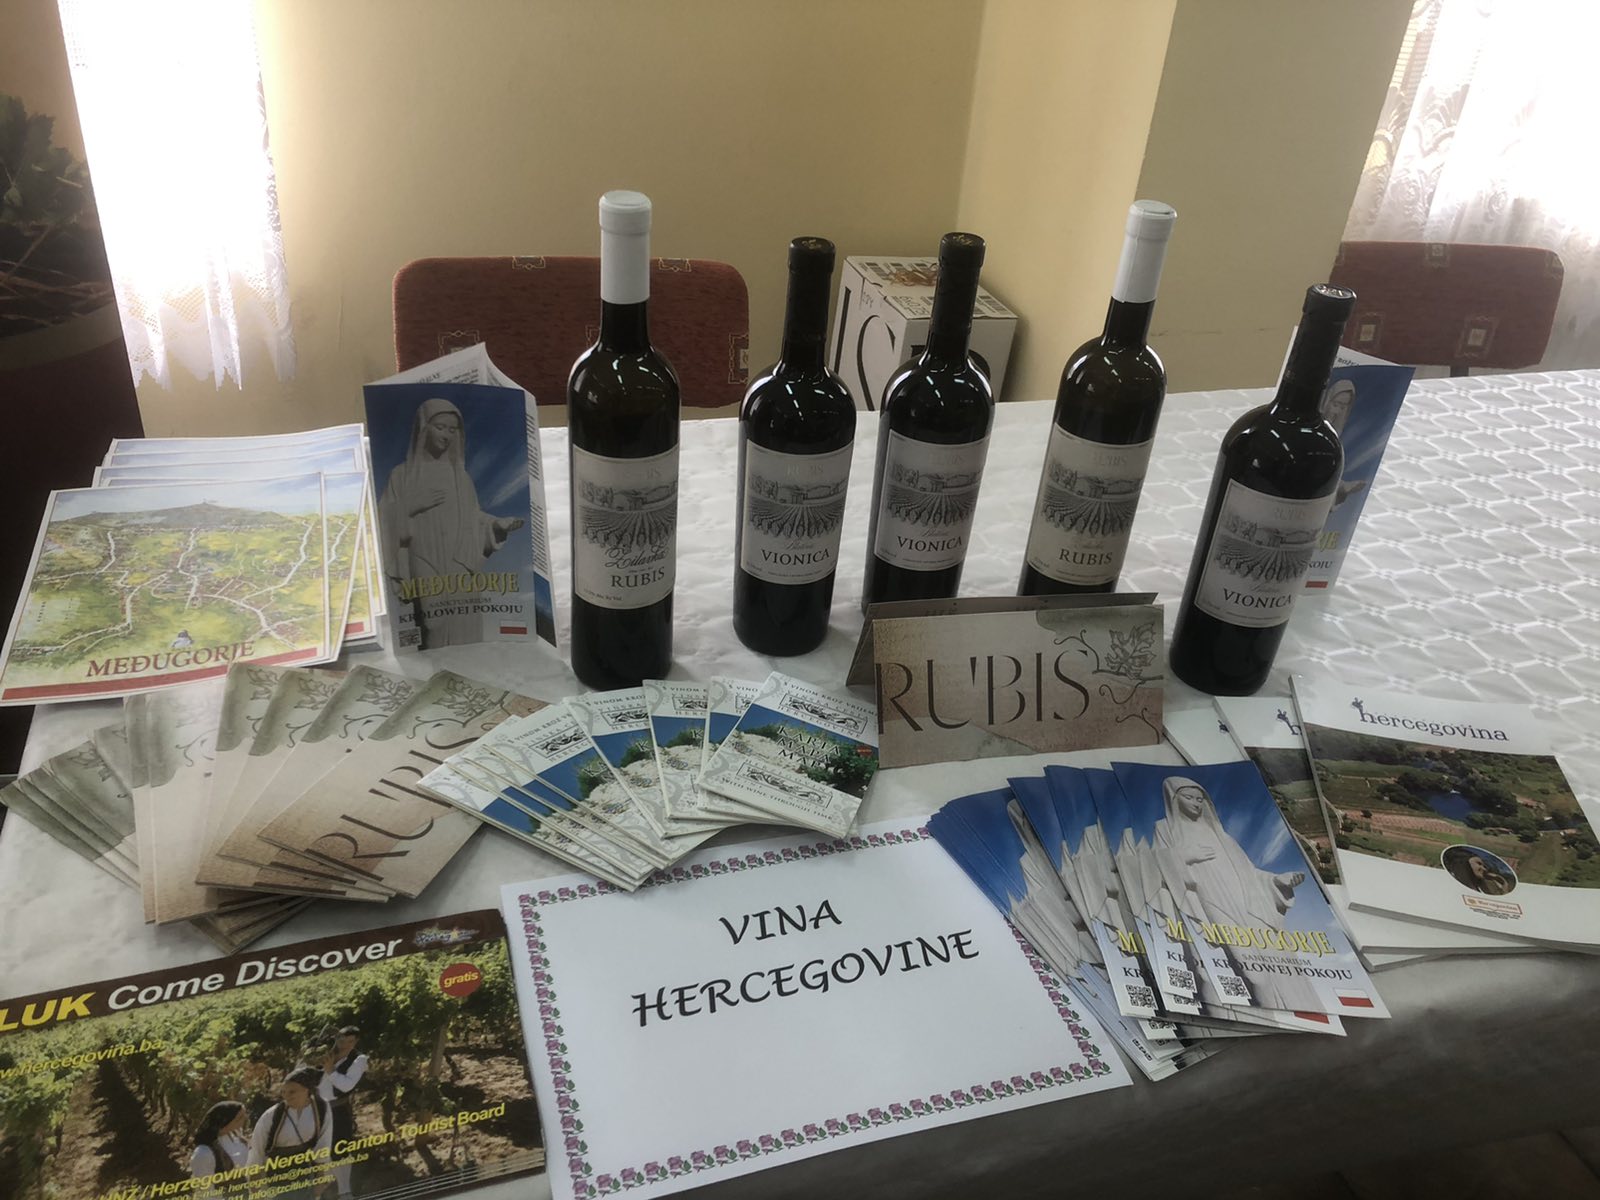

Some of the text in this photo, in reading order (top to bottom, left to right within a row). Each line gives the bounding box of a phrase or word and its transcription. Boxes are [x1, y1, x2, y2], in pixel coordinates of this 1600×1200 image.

[897, 535, 962, 552] VIONICA
[761, 548, 830, 565] VIONICA
[1059, 548, 1113, 566] RUBIS
[611, 566, 665, 588] RUBIS
[474, 604, 523, 614] POKOJU
[1223, 588, 1291, 608] VIONICA
[86, 640, 256, 678] MEĐUGORJE
[875, 651, 1090, 734] RUBIS
[1359, 708, 1509, 742] hercegovina
[718, 899, 842, 945] VINA
[1202, 921, 1336, 958] MEĐUGORJE
[1241, 953, 1312, 967] SANKTUARIUM
[108, 972, 225, 1010] Come
[235, 938, 403, 987] Discover
[444, 971, 478, 988] gratis
[631, 929, 981, 1027] HERCEGOVINE
[1295, 967, 1353, 980] POKOJU
[150, 1146, 330, 1198] Herzegovina-Neretva
[333, 1132, 395, 1156] Canton
[398, 1117, 455, 1140] Tourist
[457, 1103, 505, 1126] Board
